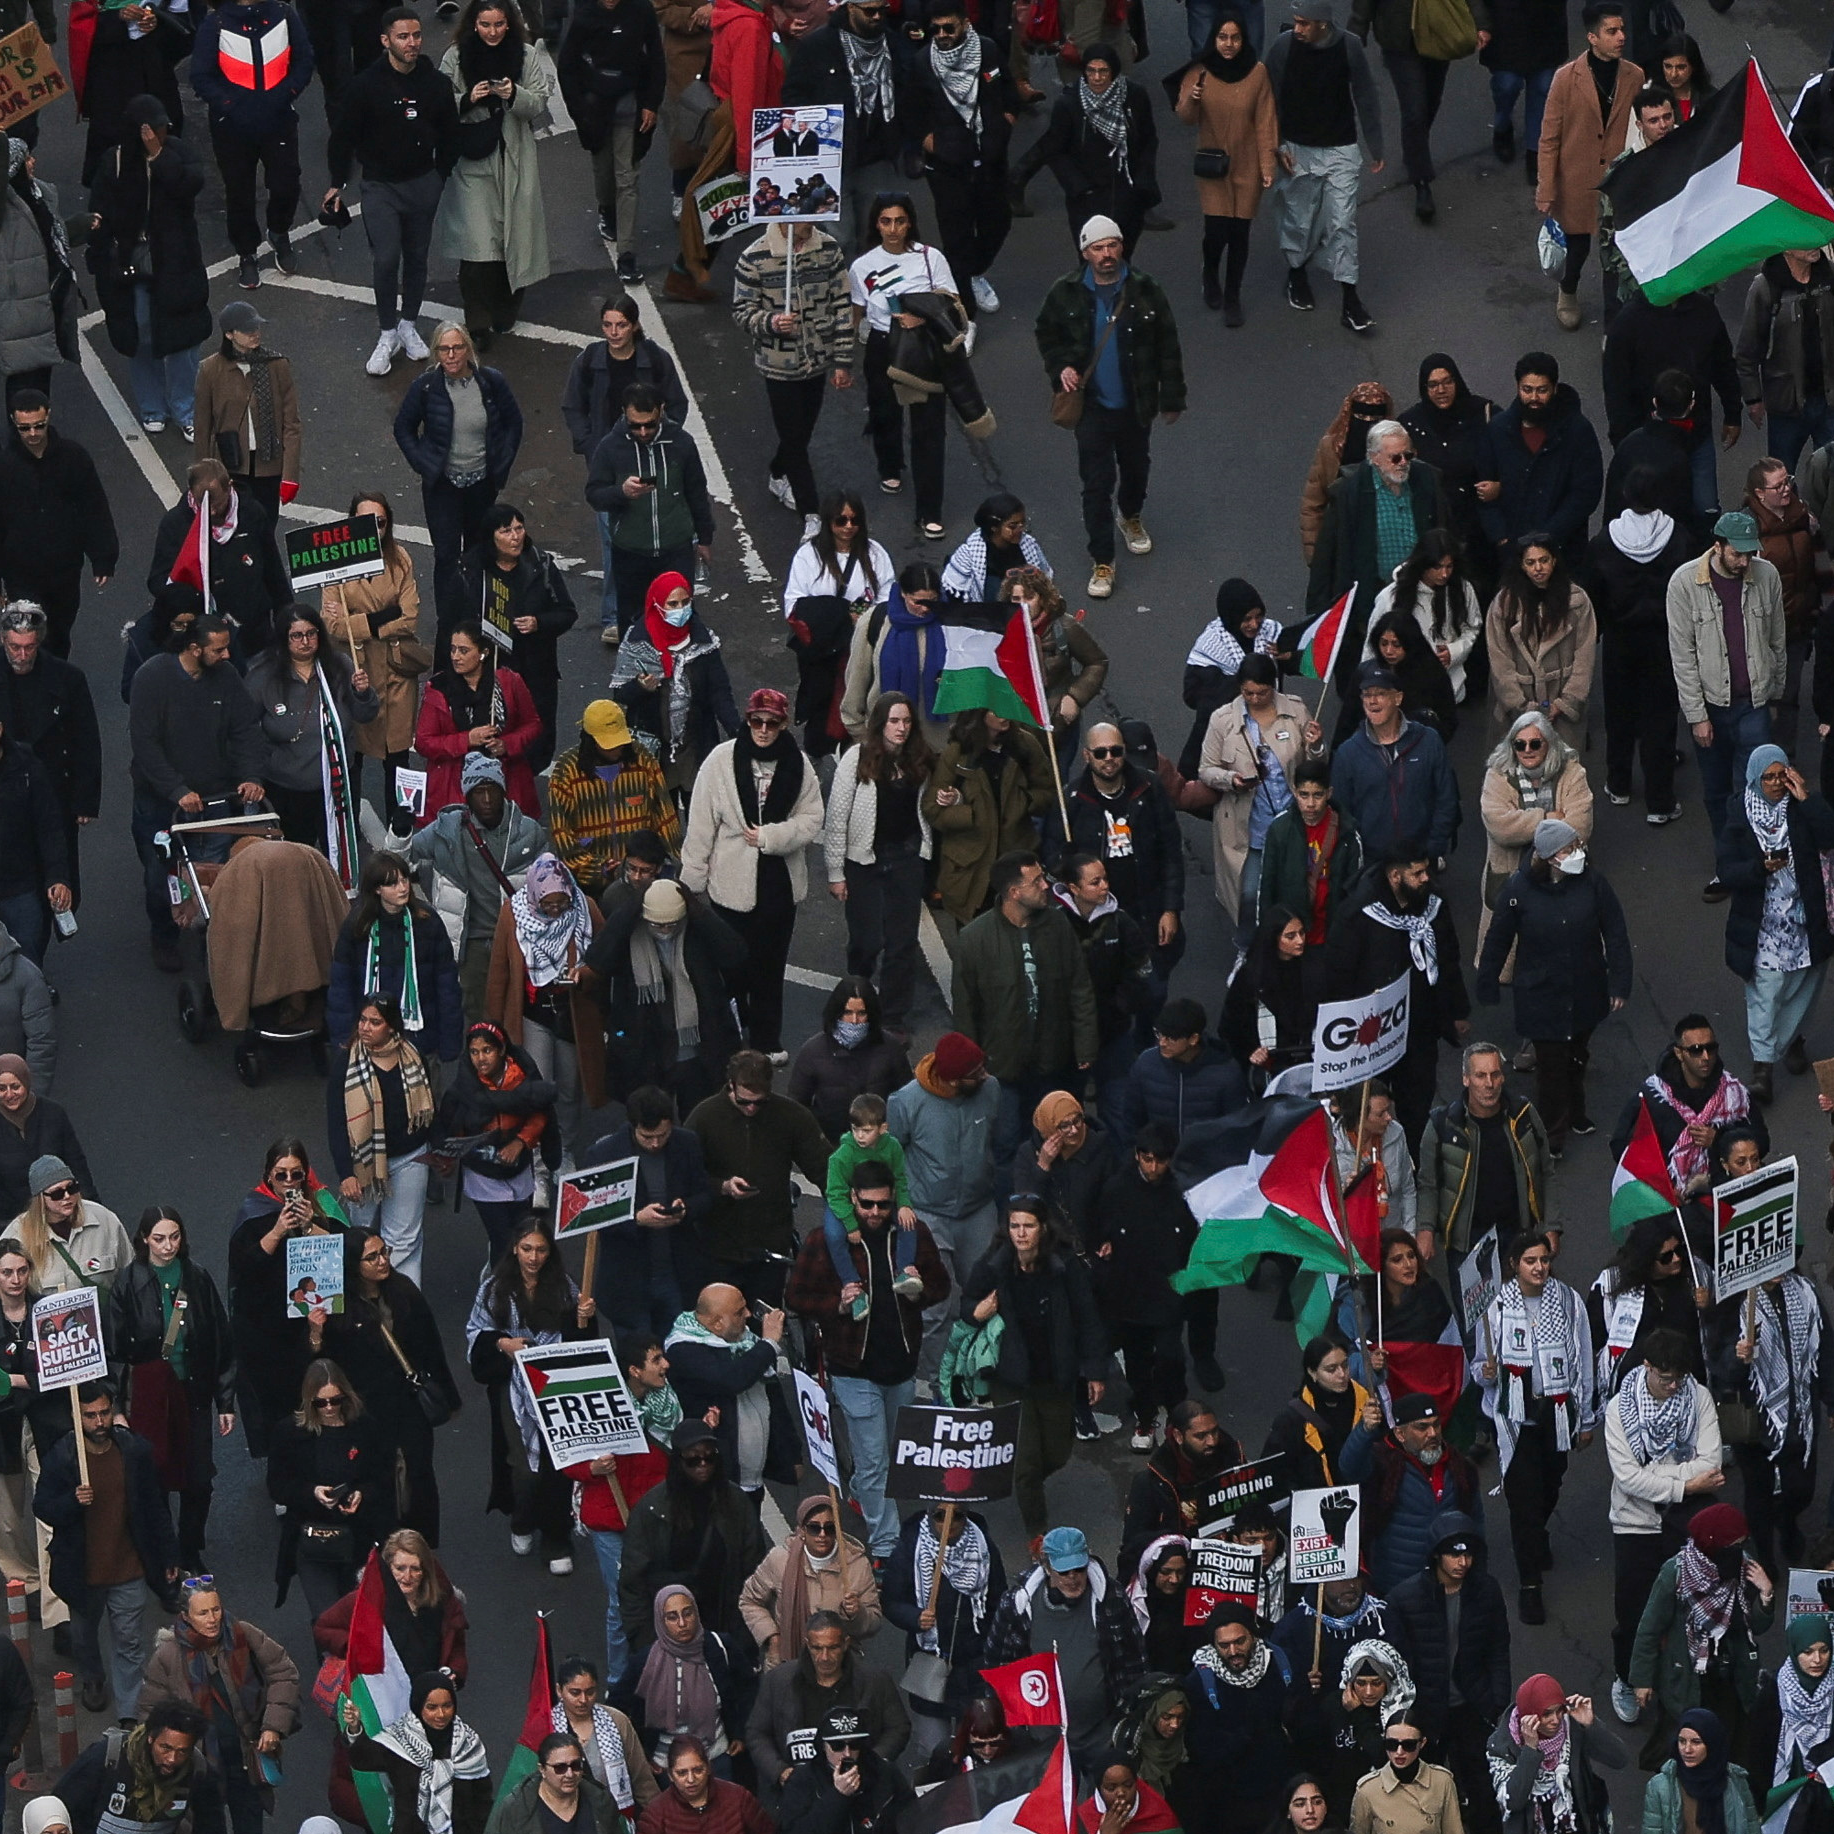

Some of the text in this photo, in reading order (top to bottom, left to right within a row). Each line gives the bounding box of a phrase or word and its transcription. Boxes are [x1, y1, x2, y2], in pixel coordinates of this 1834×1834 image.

[15, 58, 37, 79] IS
[312, 525, 352, 547] FREE
[290, 536, 378, 570] PALESTINE
[1321, 995, 1407, 1052] Gza
[1320, 1060, 1348, 1074] Stop
[1350, 1053, 1367, 1068] the
[1369, 1032, 1406, 1063] massacre
[1718, 1207, 1793, 1264] FREE
[1718, 1234, 1793, 1278] PALESTINE
[289, 1264, 319, 1274] BIRDS
[34, 1291, 94, 1314] COUNTERFIRE
[47, 1323, 90, 1348] SACK
[41, 1338, 99, 1369] SUELLA
[520, 1343, 607, 1360] Palestine Solidarity Campaign
[44, 1354, 101, 1377] FREE PALESTINE
[537, 1390, 633, 1428] FREE
[547, 1417, 637, 1443] PALESTINE
[933, 1414, 994, 1443] Free
[554, 1431, 640, 1450] END ISRAELI OCCUPATION
[895, 1439, 1015, 1469] Palestine
[1219, 1467, 1258, 1488] STOP
[1208, 1475, 1274, 1507] BOMBING
[1295, 1536, 1333, 1551] EXIST.
[1196, 1551, 1254, 1573] FREEDOM
[1295, 1549, 1338, 1565] RESIST.
[1295, 1561, 1345, 1580] RETURN.
[1192, 1572, 1256, 1593] PALESTINE
[1790, 1603, 1828, 1612] EXIST.
[792, 1731, 816, 1741] Sociali
